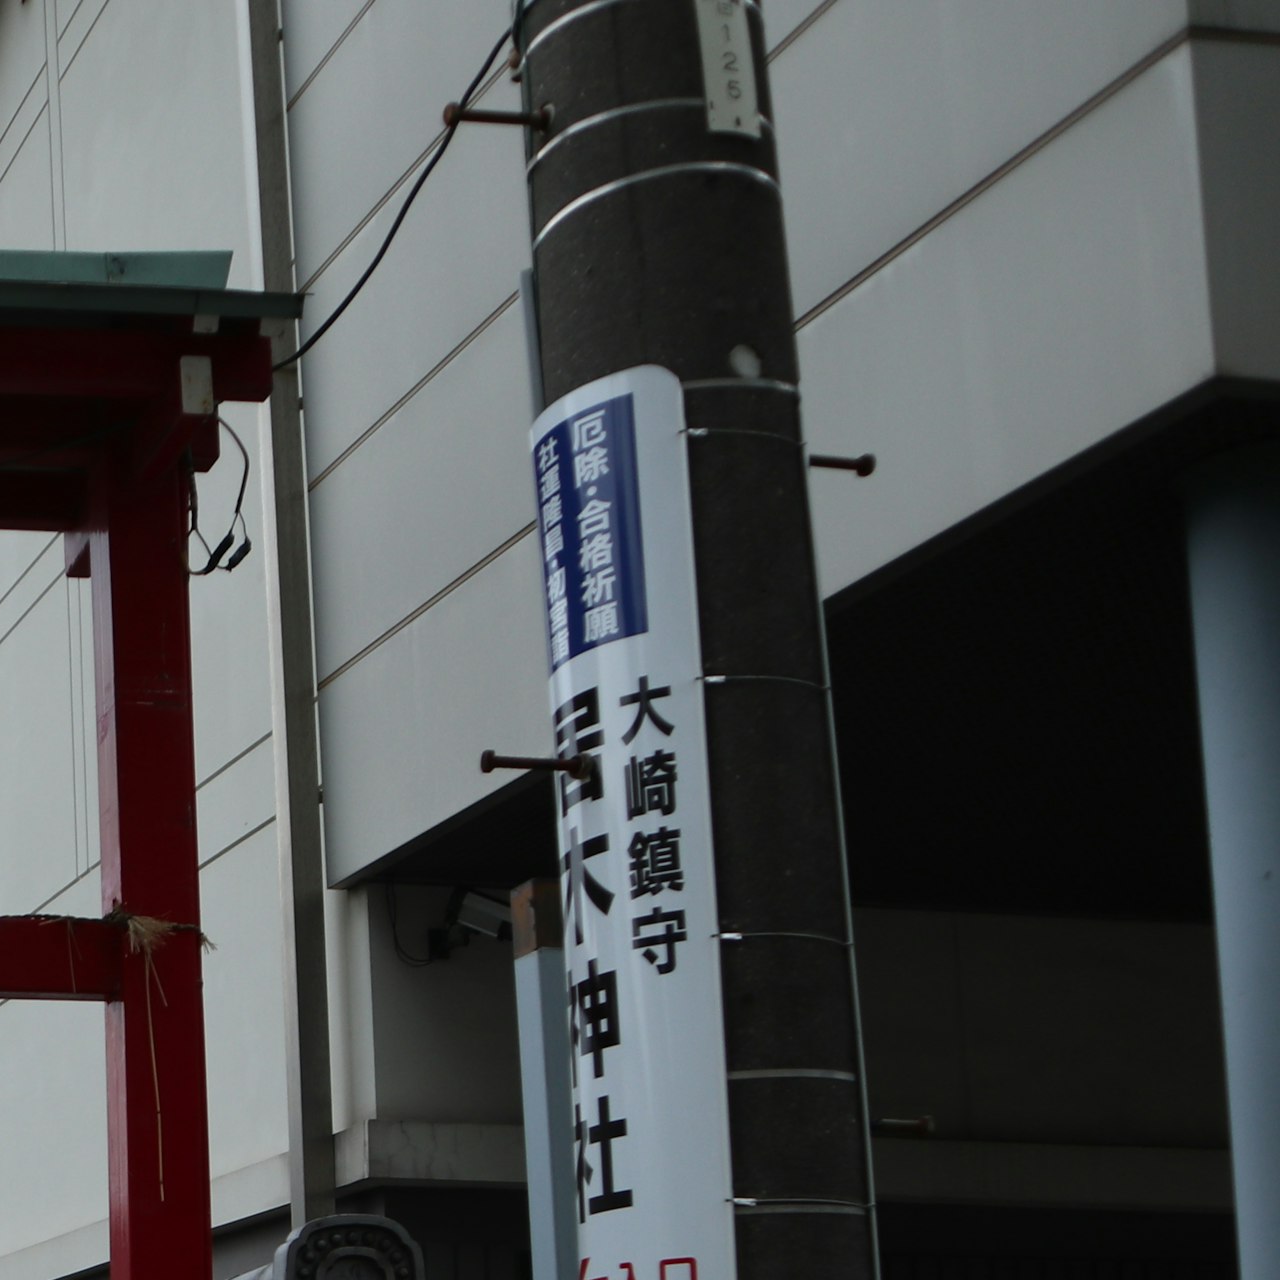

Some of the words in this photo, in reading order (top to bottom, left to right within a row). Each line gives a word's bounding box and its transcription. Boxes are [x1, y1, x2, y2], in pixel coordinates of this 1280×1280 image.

[572, 407, 620, 644] 厄除・合格祈願
[619, 675, 687, 976] 大崎鎮守
